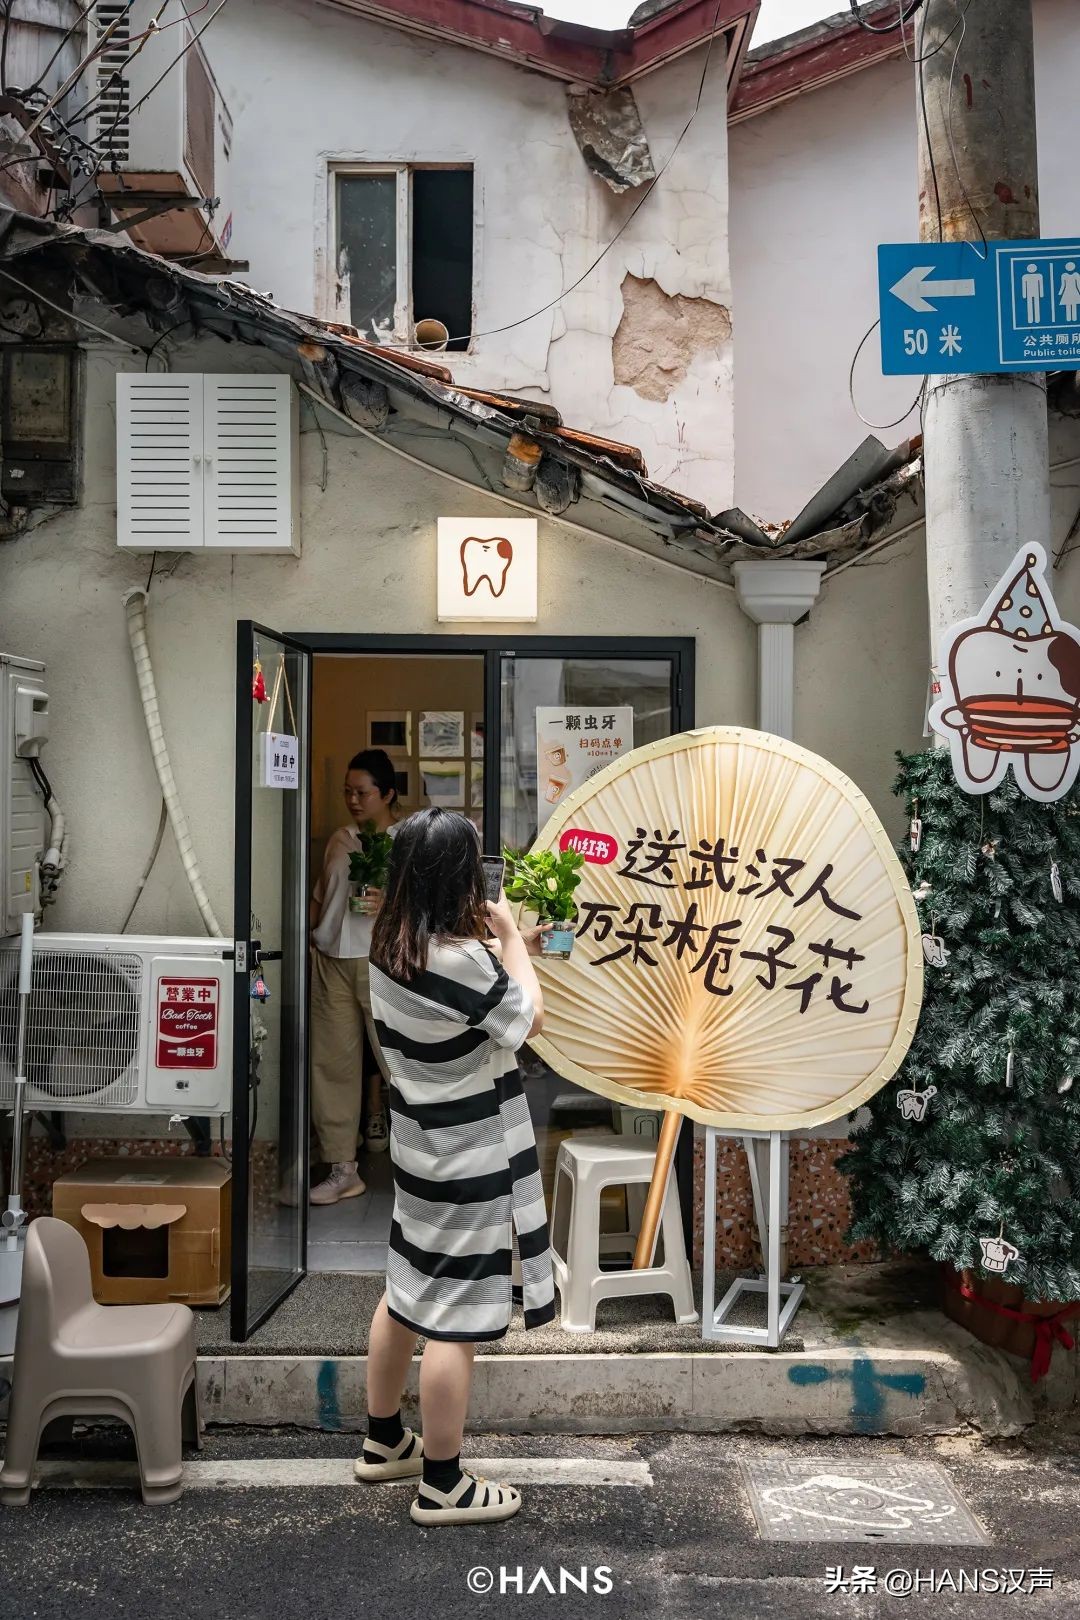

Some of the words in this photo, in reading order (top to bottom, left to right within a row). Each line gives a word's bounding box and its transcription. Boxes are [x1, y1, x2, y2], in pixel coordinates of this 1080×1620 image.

[903, 329, 928, 355] 50
[939, 324, 963, 357] 米
[1023, 349, 1056, 357] Public
[548, 714, 617, 731] 一颗虫牙
[579, 737, 623, 749] 扫码点单
[568, 835, 610, 859] 小红书
[616, 827, 863, 921] 送武汉人
[536, 902, 870, 1015] 万朵栀子花
[161, 1008, 185, 1020] Bad
[186, 1008, 213, 1021] Tooth
